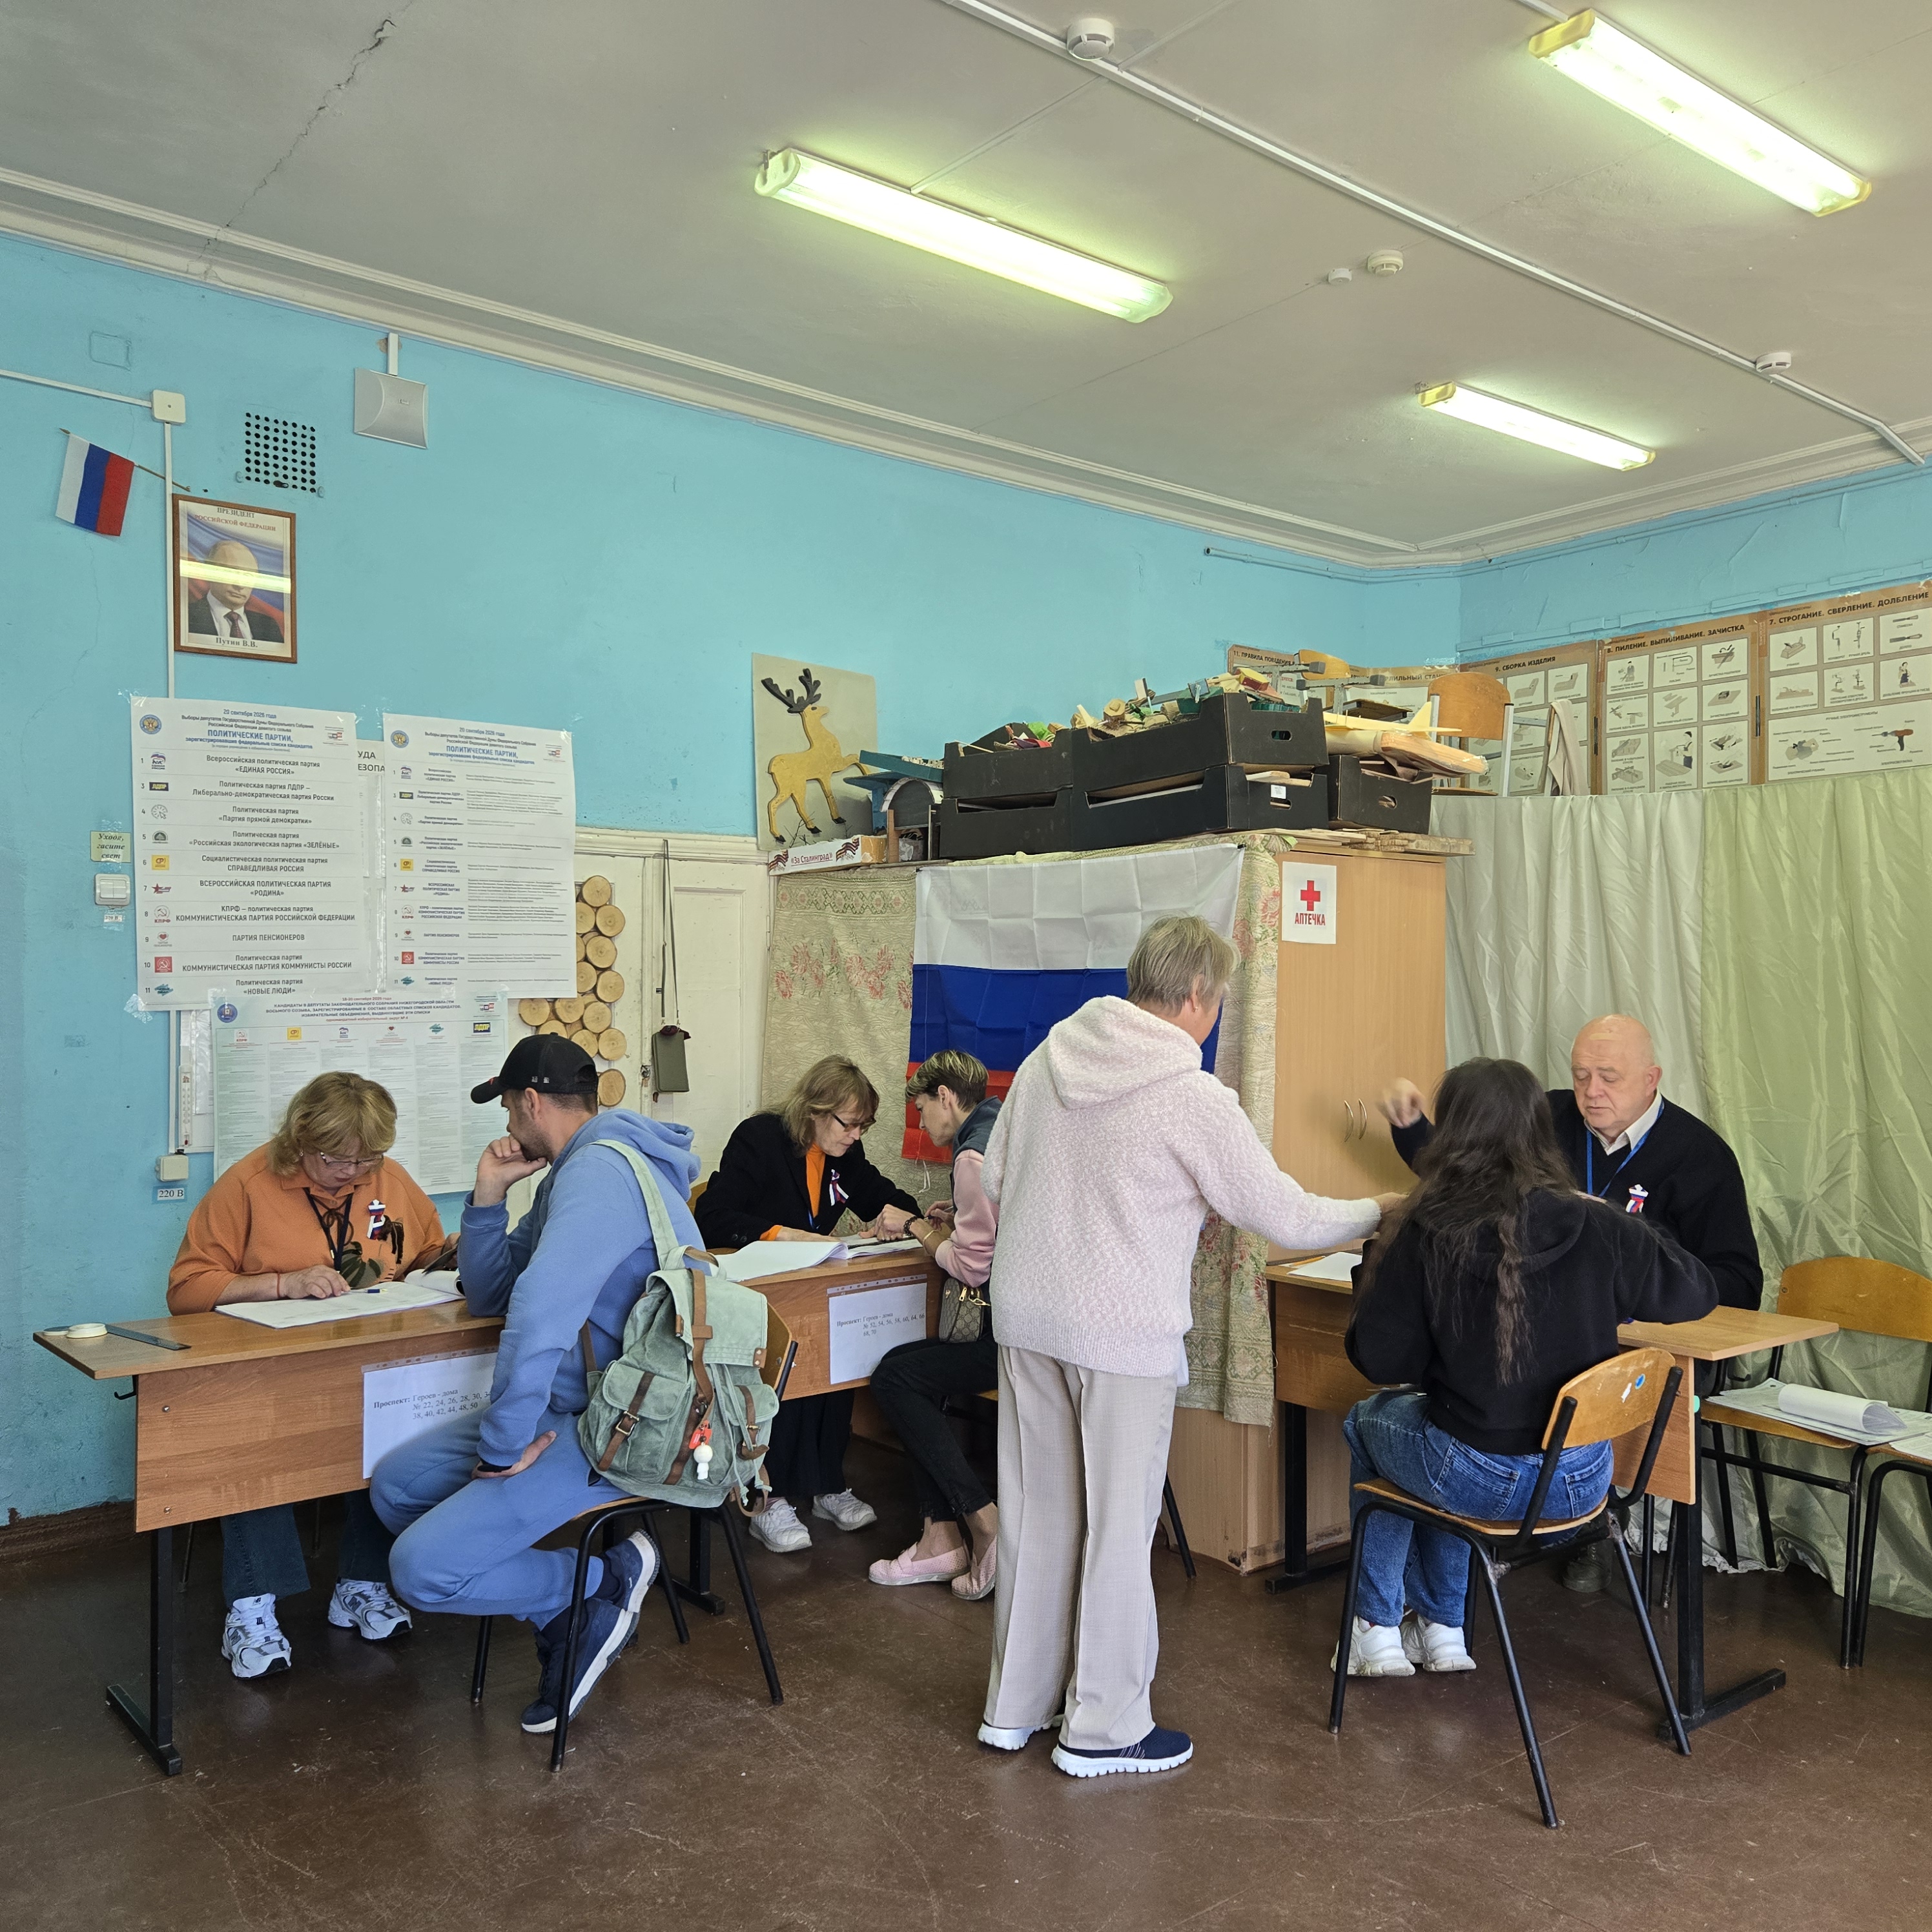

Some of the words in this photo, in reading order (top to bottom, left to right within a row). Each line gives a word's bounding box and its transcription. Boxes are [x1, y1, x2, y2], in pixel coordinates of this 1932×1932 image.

[217, 508, 255, 519] ПРЕЗИДЕНТ
[195, 515, 238, 526] РОССИЙСКОЙ
[240, 521, 276, 531] ФЕДЕРАЦИИ
[1779, 610, 1824, 623] СТРОГАНИЕ.
[1827, 602, 1875, 615] СВЕРЛЕНИЕ.
[1878, 592, 1929, 607] ДОЛБЛЕНИЕ
[216, 637, 240, 646] Путин
[1616, 642, 1648, 652] ПИЛЕНИЕ.
[1708, 624, 1745, 635] ЗАЧИСТКА
[1242, 652, 1263, 661] ПРАВИЛА
[1503, 662, 1526, 671] СБОРКА
[1528, 657, 1556, 666] ИЗДЕЛИЯ
[208, 730, 263, 739] ПОЛИТИЧЕСКИЕ
[265, 734, 293, 743] ПАРТИИ,
[447, 746, 493, 755] ПОЛИТИЧЕСКИЕ
[495, 749, 518, 759] ПАРТИИ,
[192, 789, 289, 799] Либерально-демократическая
[98, 833, 124, 841] Уходя,
[801, 853, 832, 862] Сталинград»
[1295, 913, 1325, 925] АПТЕЧКА
[374, 1397, 410, 1409] Проспект:
[413, 1393, 436, 1402] Героев
[442, 1389, 458, 1397] дома
[447, 1397, 458, 1406] 26,
[460, 1395, 470, 1403] 28,
